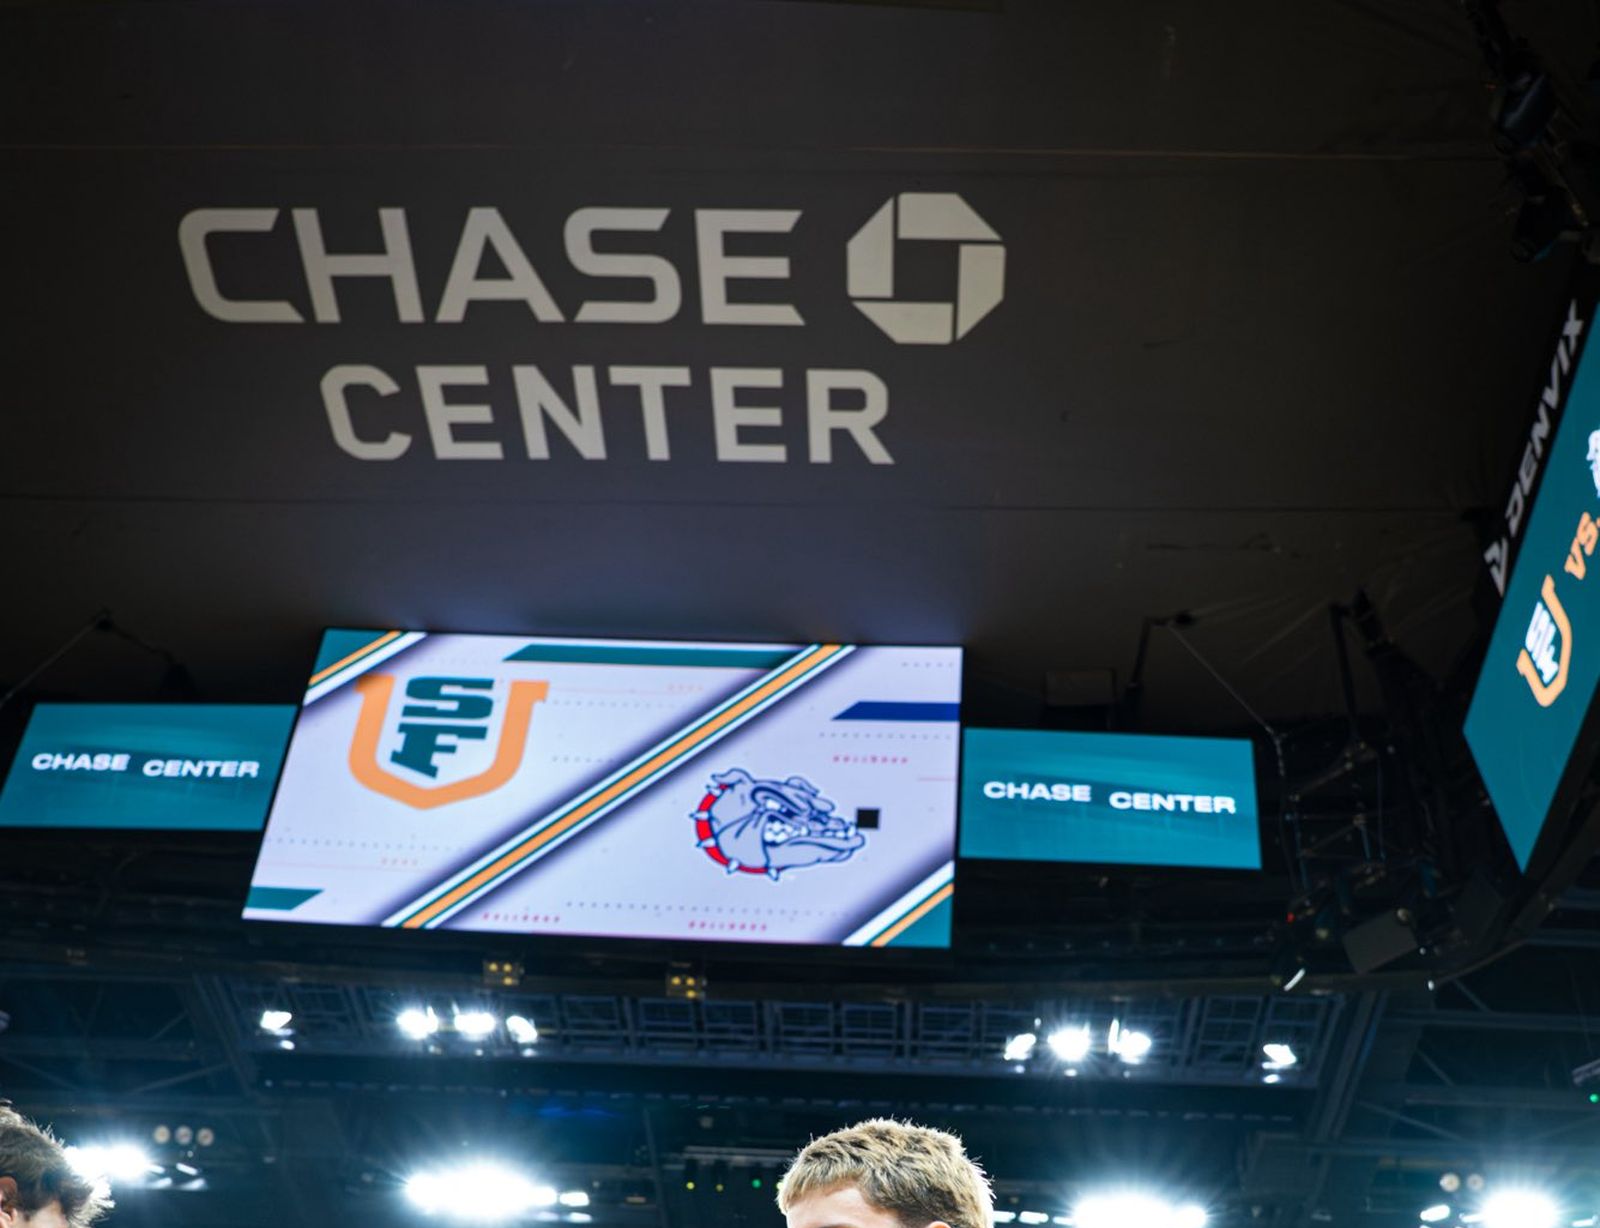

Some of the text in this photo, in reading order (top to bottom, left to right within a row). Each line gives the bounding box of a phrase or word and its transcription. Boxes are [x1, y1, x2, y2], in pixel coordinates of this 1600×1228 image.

[178, 206, 806, 325] CHASE
[320, 364, 895, 465] CENTER
[1505, 299, 1583, 537] DENVIX
[31, 752, 259, 778] CHASE CENTER
[983, 781, 1236, 814] CHASE CENTER
